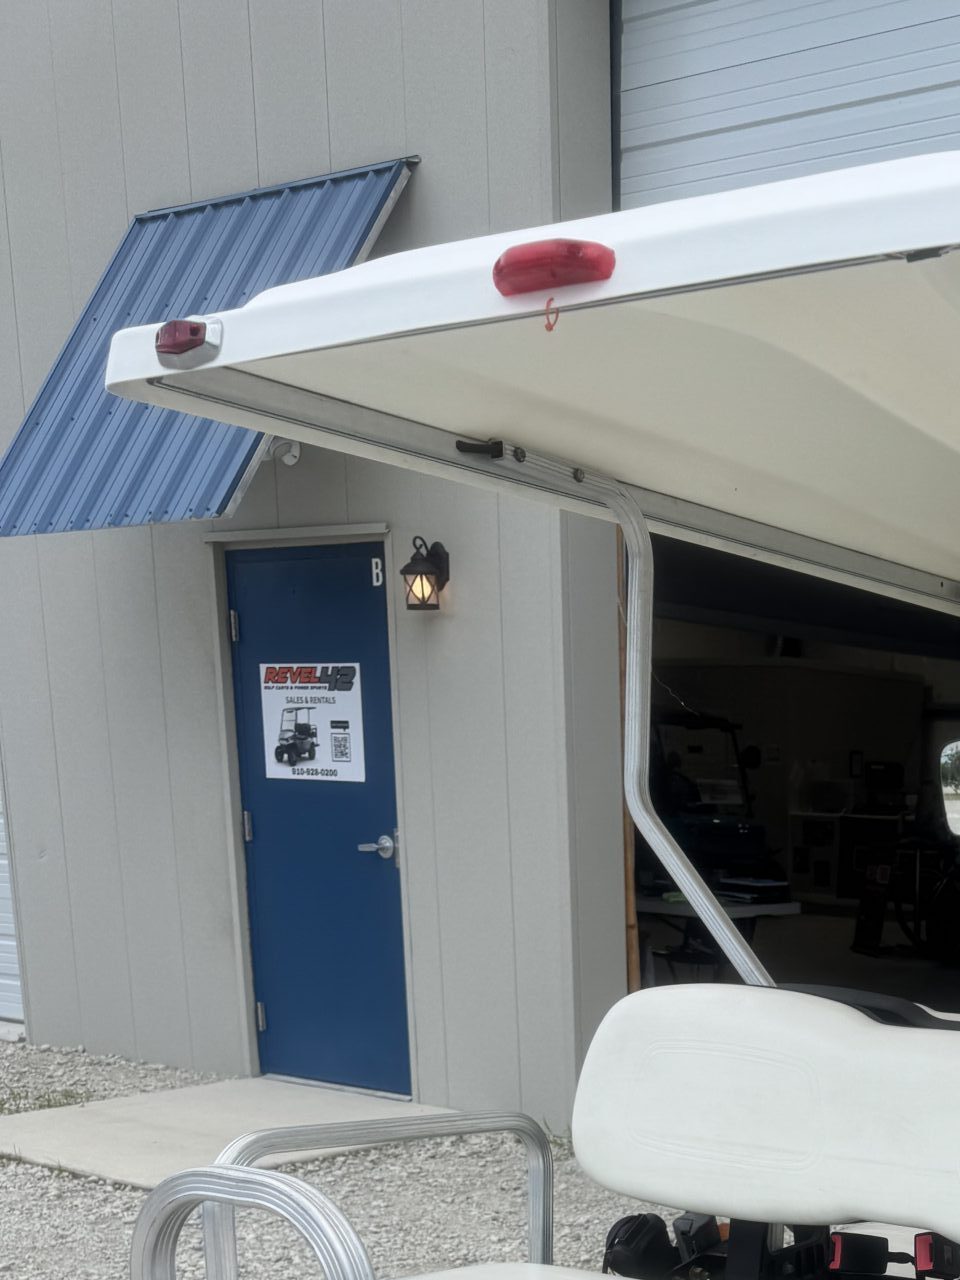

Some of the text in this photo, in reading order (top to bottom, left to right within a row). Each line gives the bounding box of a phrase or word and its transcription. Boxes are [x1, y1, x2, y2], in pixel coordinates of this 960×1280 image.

[371, 557, 384, 587] B
[285, 696, 304, 704] SALES
[310, 696, 337, 704] RENTALS
